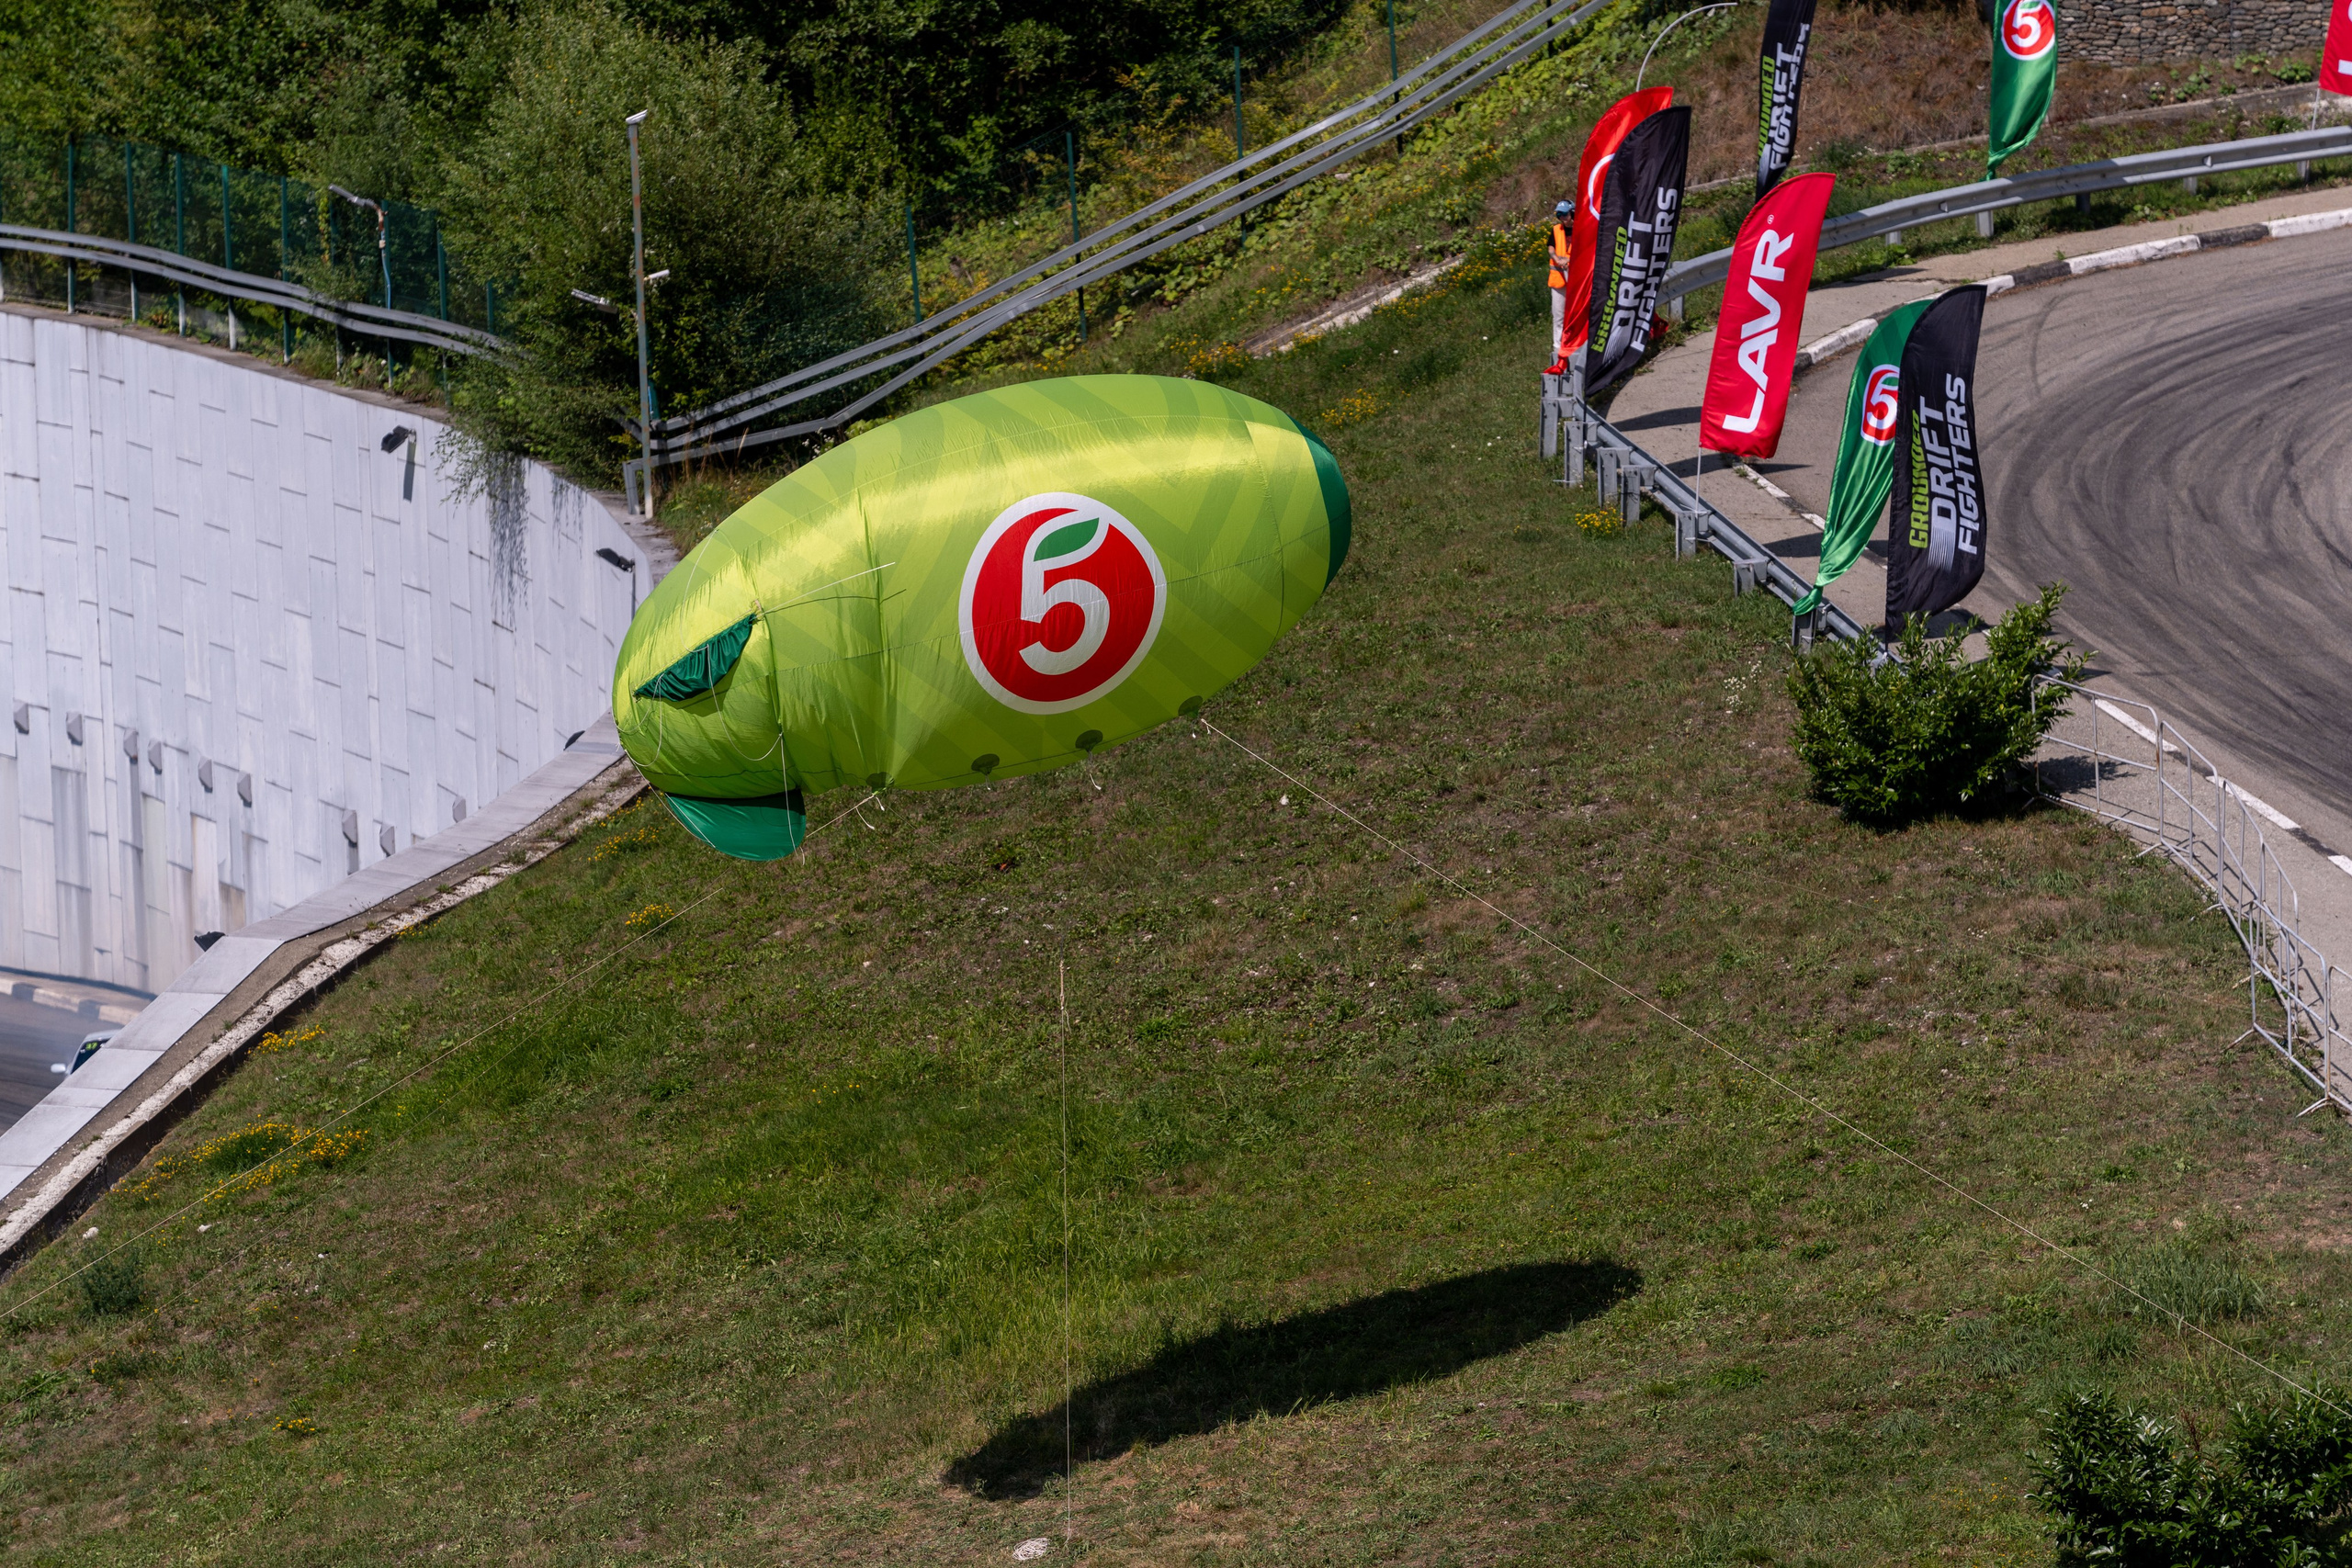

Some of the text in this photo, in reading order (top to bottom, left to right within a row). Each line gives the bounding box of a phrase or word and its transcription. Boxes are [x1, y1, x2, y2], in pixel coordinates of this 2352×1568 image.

[2011, 0, 2044, 49] 5
[1602, 211, 1652, 364] DRIFT
[1630, 186, 1678, 353] FIGHTERS
[1722, 229, 1794, 434] LAVR
[1867, 372, 1900, 430] 5
[1908, 410, 1929, 549] GROUNDED
[1919, 396, 1958, 571] DRIFT
[1945, 373, 1980, 555] FIGHTERS
[1019, 508, 1111, 676] 5
